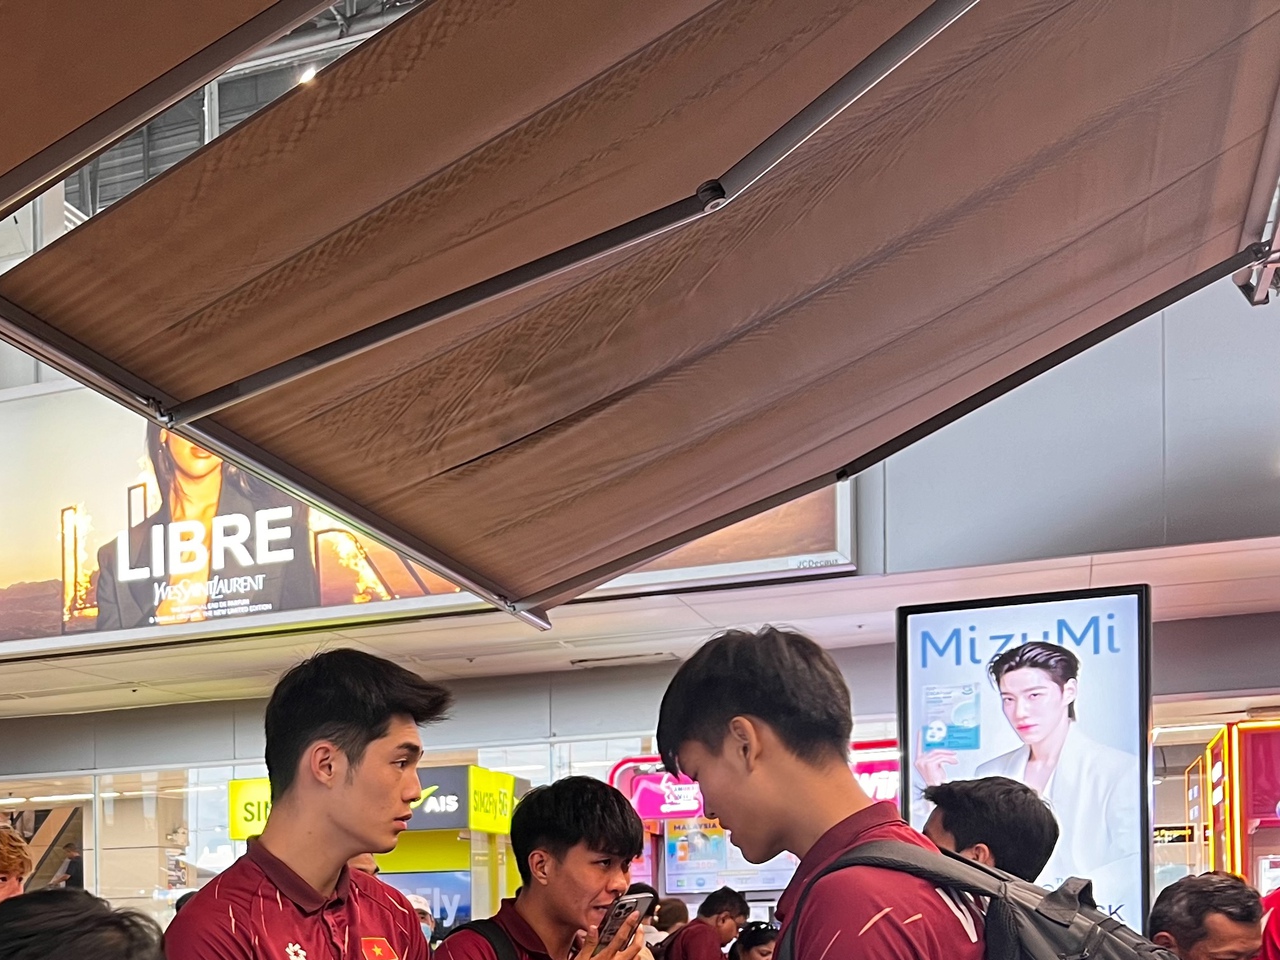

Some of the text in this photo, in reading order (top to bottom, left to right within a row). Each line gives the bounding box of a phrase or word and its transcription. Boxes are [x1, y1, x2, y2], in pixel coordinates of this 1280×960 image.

[117, 506, 295, 582] LIBRE
[424, 794, 458, 814] AIS
[473, 789, 508, 821] SIM2Fly 5G
[673, 822, 718, 831] MALAYSIA
